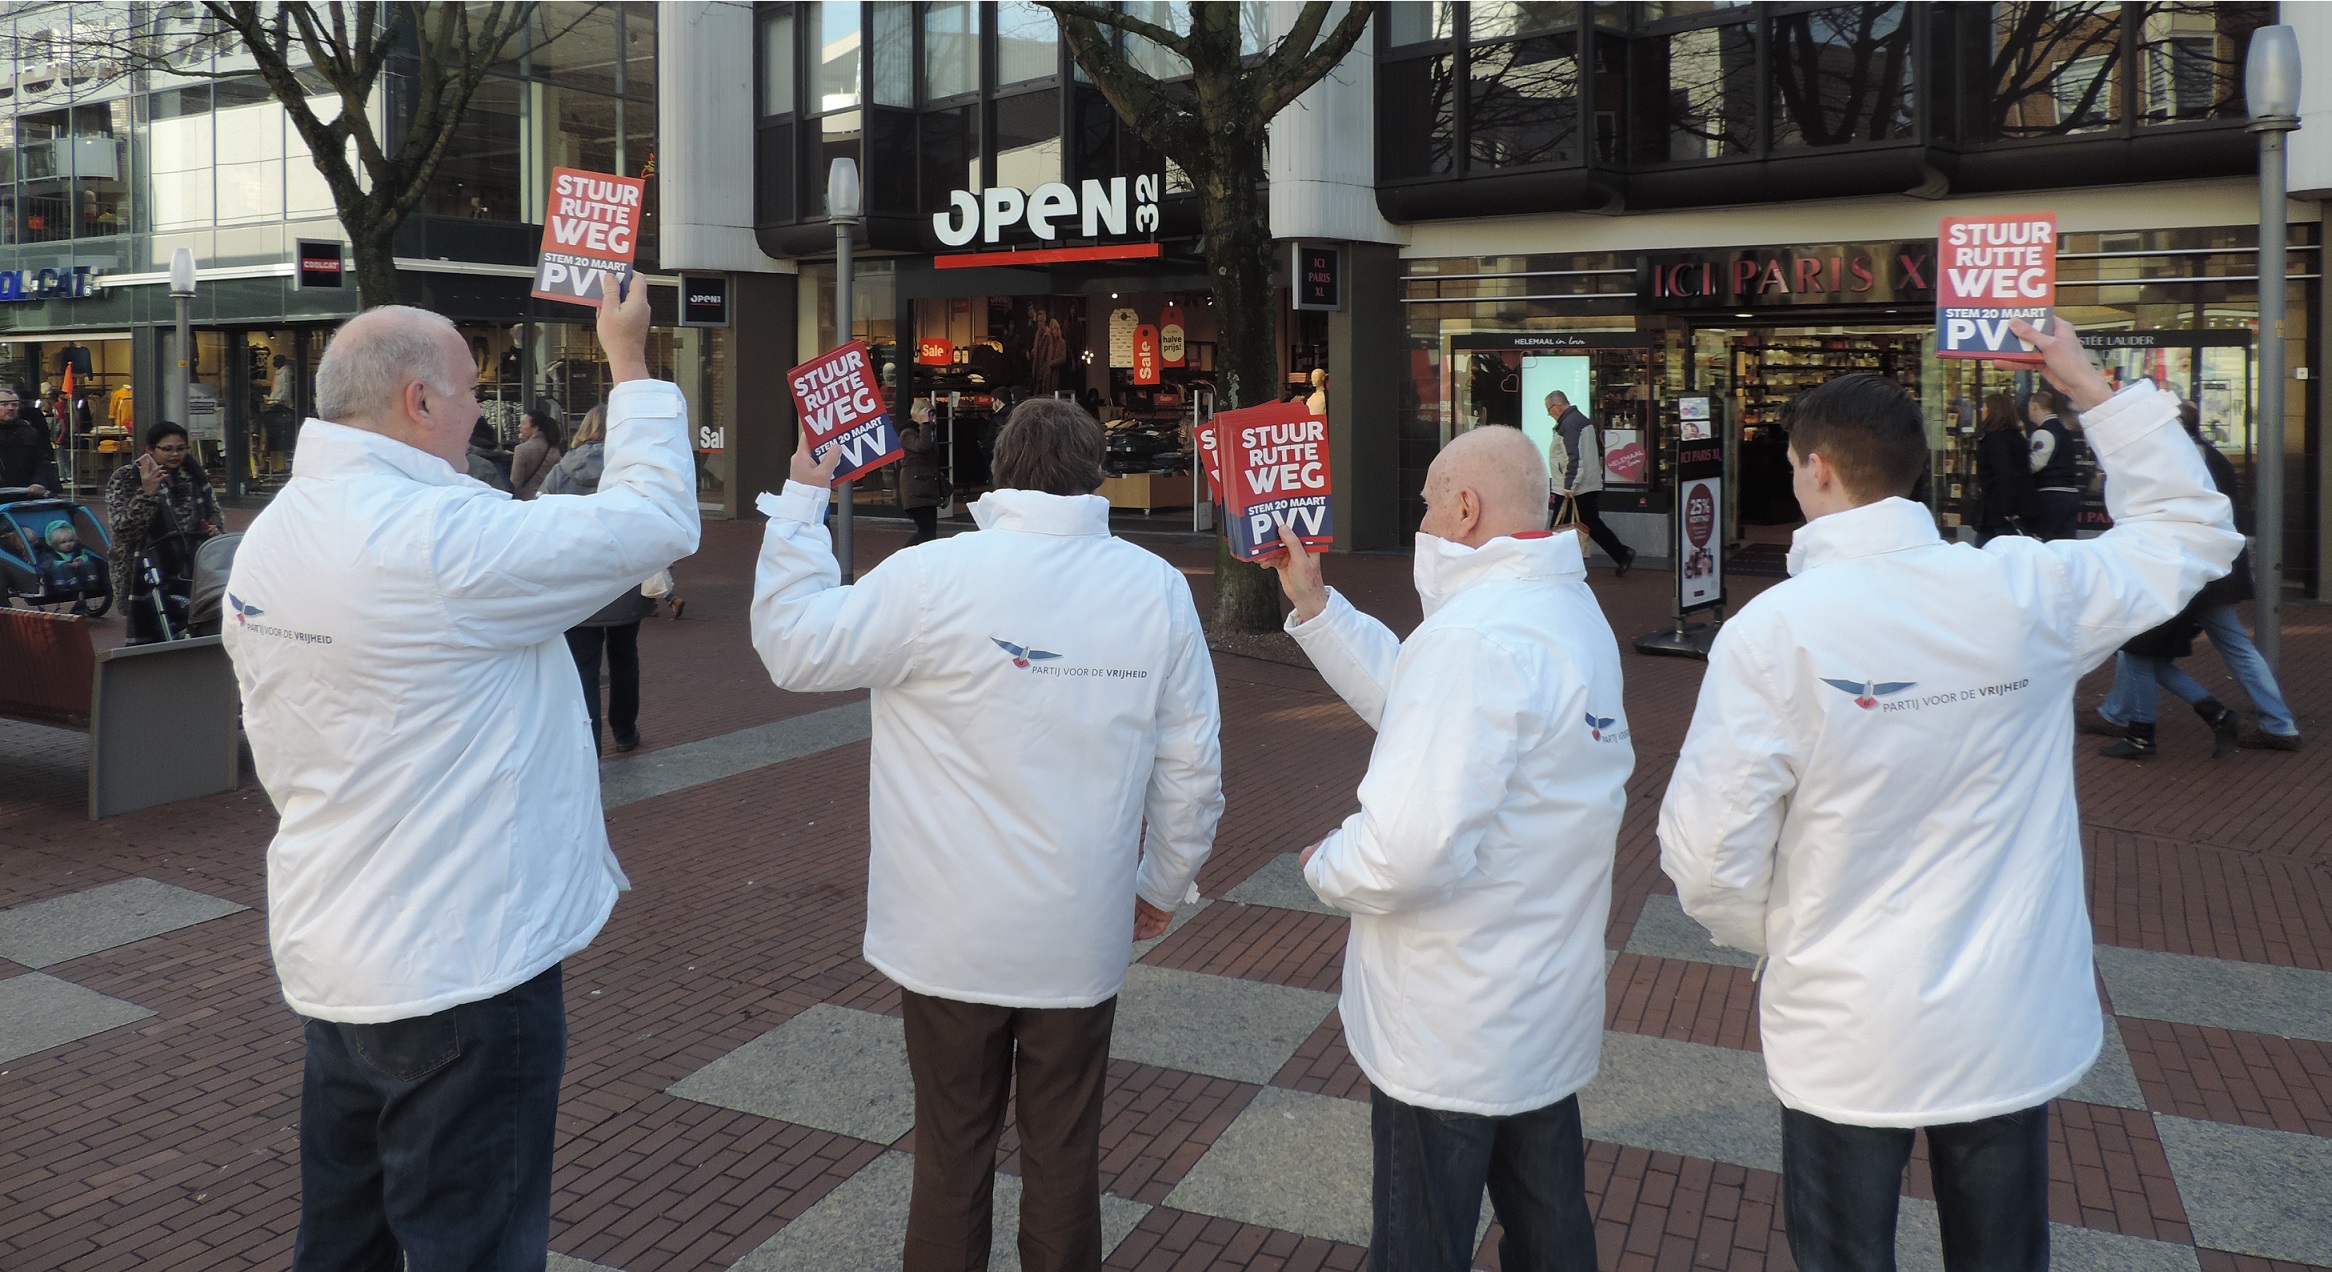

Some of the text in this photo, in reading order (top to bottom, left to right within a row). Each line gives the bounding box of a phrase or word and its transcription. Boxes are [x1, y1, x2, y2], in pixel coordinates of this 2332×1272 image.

[556, 174, 639, 207] STUUR
[1135, 173, 1159, 233] 32
[560, 197, 630, 225] RUTTE
[552, 215, 631, 254] WEG
[1948, 221, 2052, 246] STUUR
[304, 261, 338, 270] COOLCAT
[544, 252, 628, 272] STEM 20 MAART
[1314, 257, 1325, 268] ICI
[1956, 246, 2043, 267] RUTTE
[1308, 271, 1331, 283] PARIS
[1654, 254, 1936, 298] ICI PARIS X
[1947, 267, 2047, 299] WEG
[1315, 286, 1325, 297] XL
[1945, 307, 2047, 318] STEM 20 MAART
[922, 344, 944, 357] Sale
[1162, 335, 1182, 343] halve
[1163, 343, 1182, 353] prijs!
[2107, 336, 2154, 346] LAUDER
[1138, 340, 1152, 379] Sale
[794, 350, 864, 397] STUUR
[804, 370, 865, 412] RUTTE
[804, 387, 877, 437] WEG
[814, 416, 882, 456] STEM 20 MAART
[1241, 421, 1325, 449] STUUR
[1250, 442, 1319, 467] RUTTE
[1244, 461, 1325, 495] WEG
[1248, 496, 1326, 515] STEM 20 MAART
[1250, 505, 1326, 545] PVV
[247, 623, 333, 645] PARTIJ VOOR DE VRIJHEID
[1032, 666, 1148, 680] PARTIJ VOOR DE VRIJHEID
[1883, 678, 2030, 713] PARTIJ VOOR DE VRIJHEID
